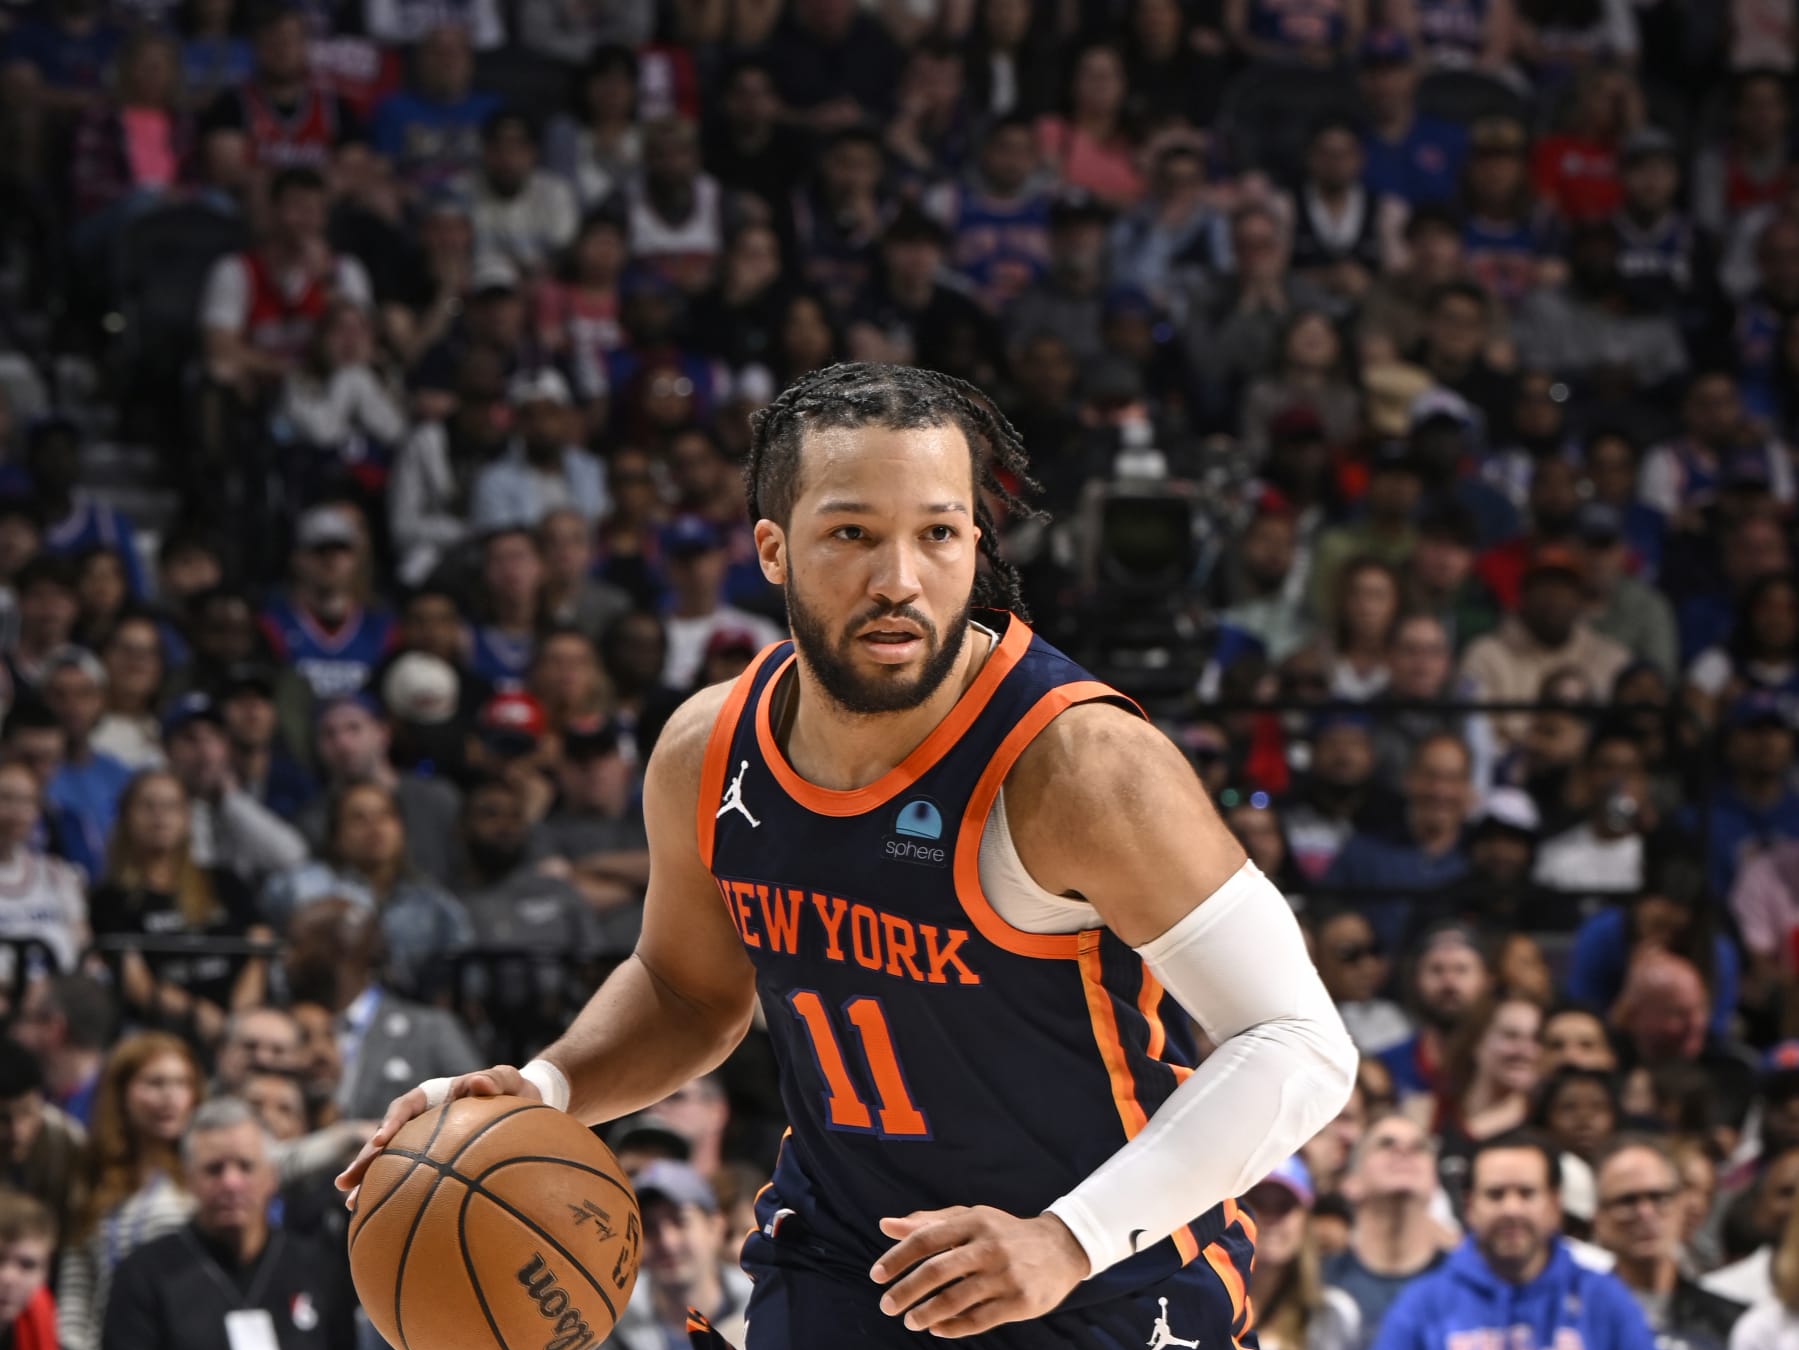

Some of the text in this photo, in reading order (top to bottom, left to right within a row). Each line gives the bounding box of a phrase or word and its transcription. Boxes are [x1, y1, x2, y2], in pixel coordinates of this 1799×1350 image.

[885, 841, 945, 862] sphere
[812, 892, 982, 986] YORK
[786, 987, 934, 1142] 11
